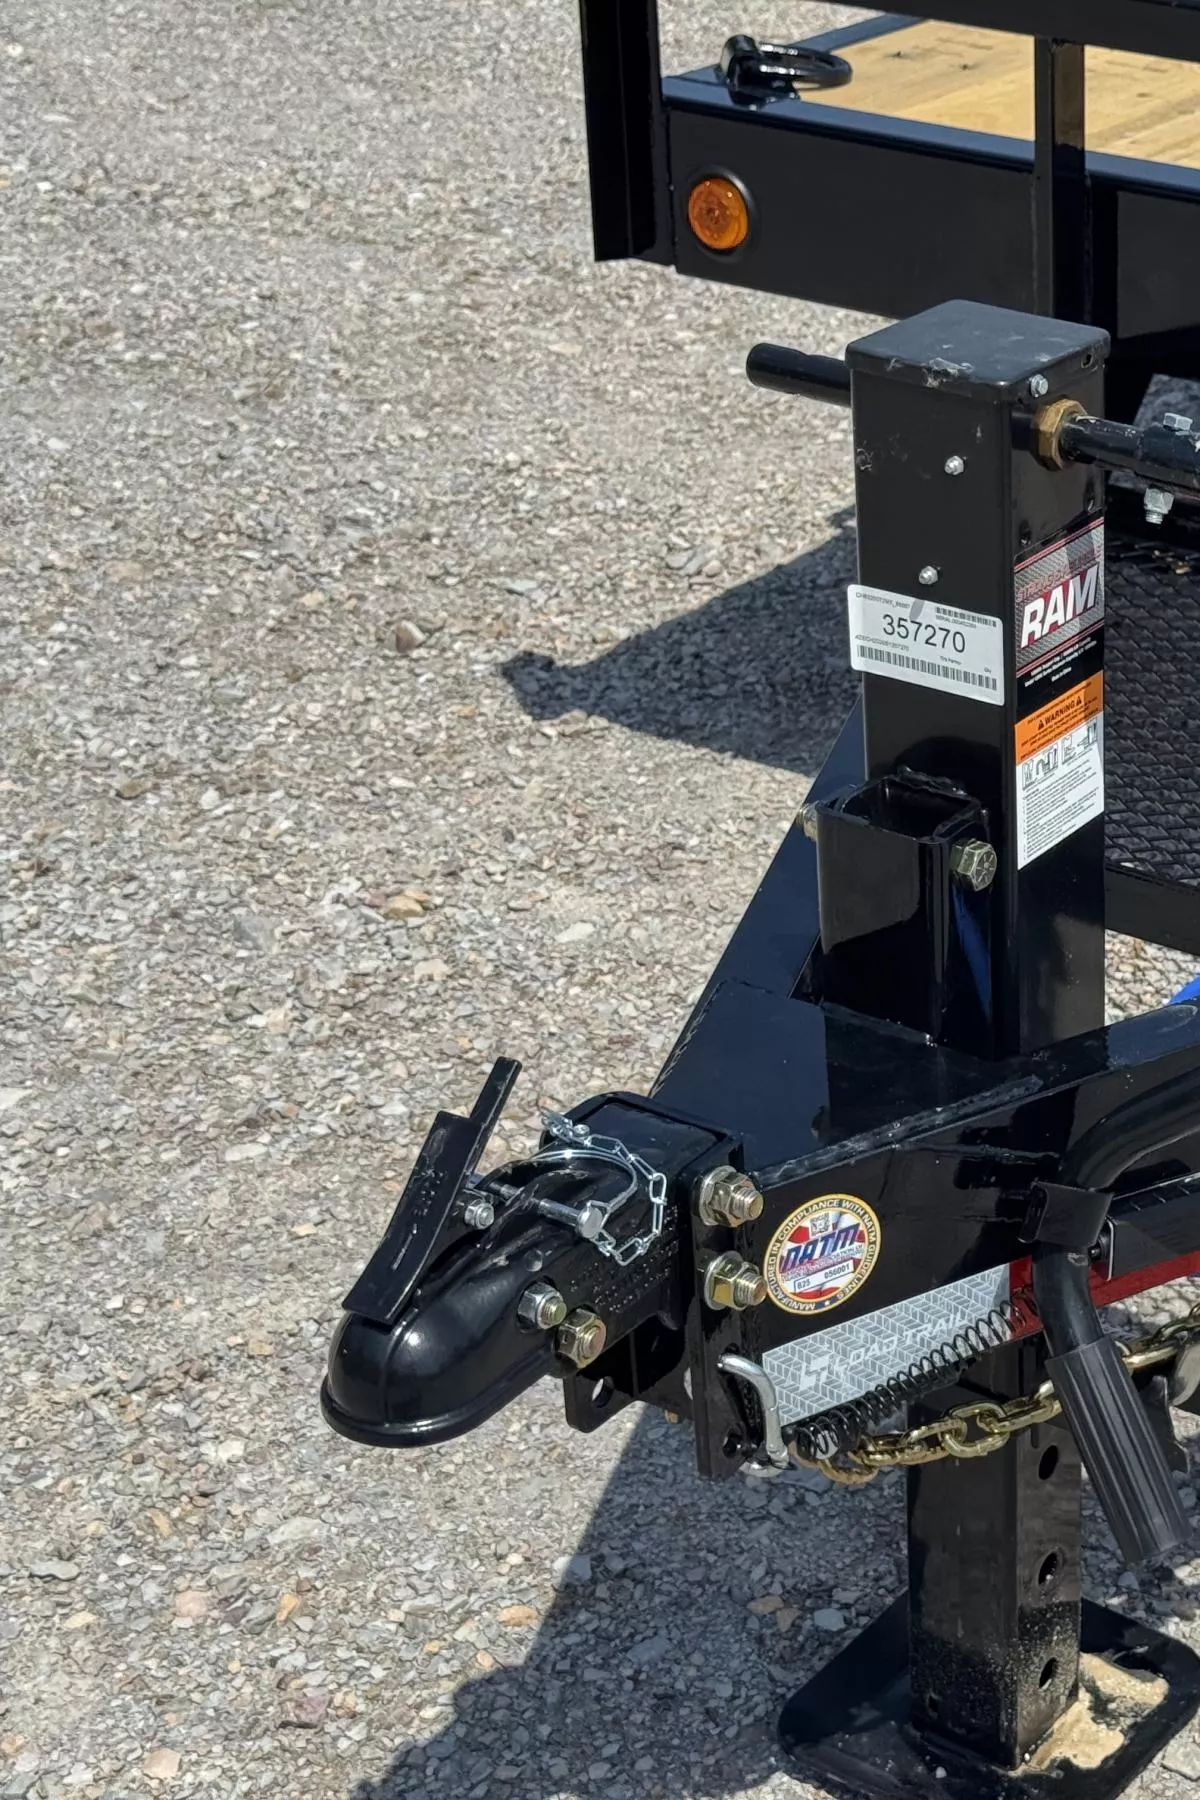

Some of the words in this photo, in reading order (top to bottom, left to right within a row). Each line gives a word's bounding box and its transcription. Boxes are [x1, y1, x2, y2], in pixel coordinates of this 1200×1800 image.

[1020, 562, 1100, 648] RAM
[882, 614, 966, 654] 357270
[1044, 700, 1076, 725] WARNING
[778, 1199, 840, 1239] COMPLIANCE
[842, 1199, 865, 1216] WITH
[781, 1223, 861, 1273] NATM
[863, 1214, 877, 1242] NATM
[771, 1243, 781, 1254] IN
[769, 1258, 816, 1311] MANUFACTURED
[836, 1244, 877, 1299] GUIDELINES
[834, 1336, 898, 1377] LOAD
[904, 1312, 969, 1344] TRAIL
